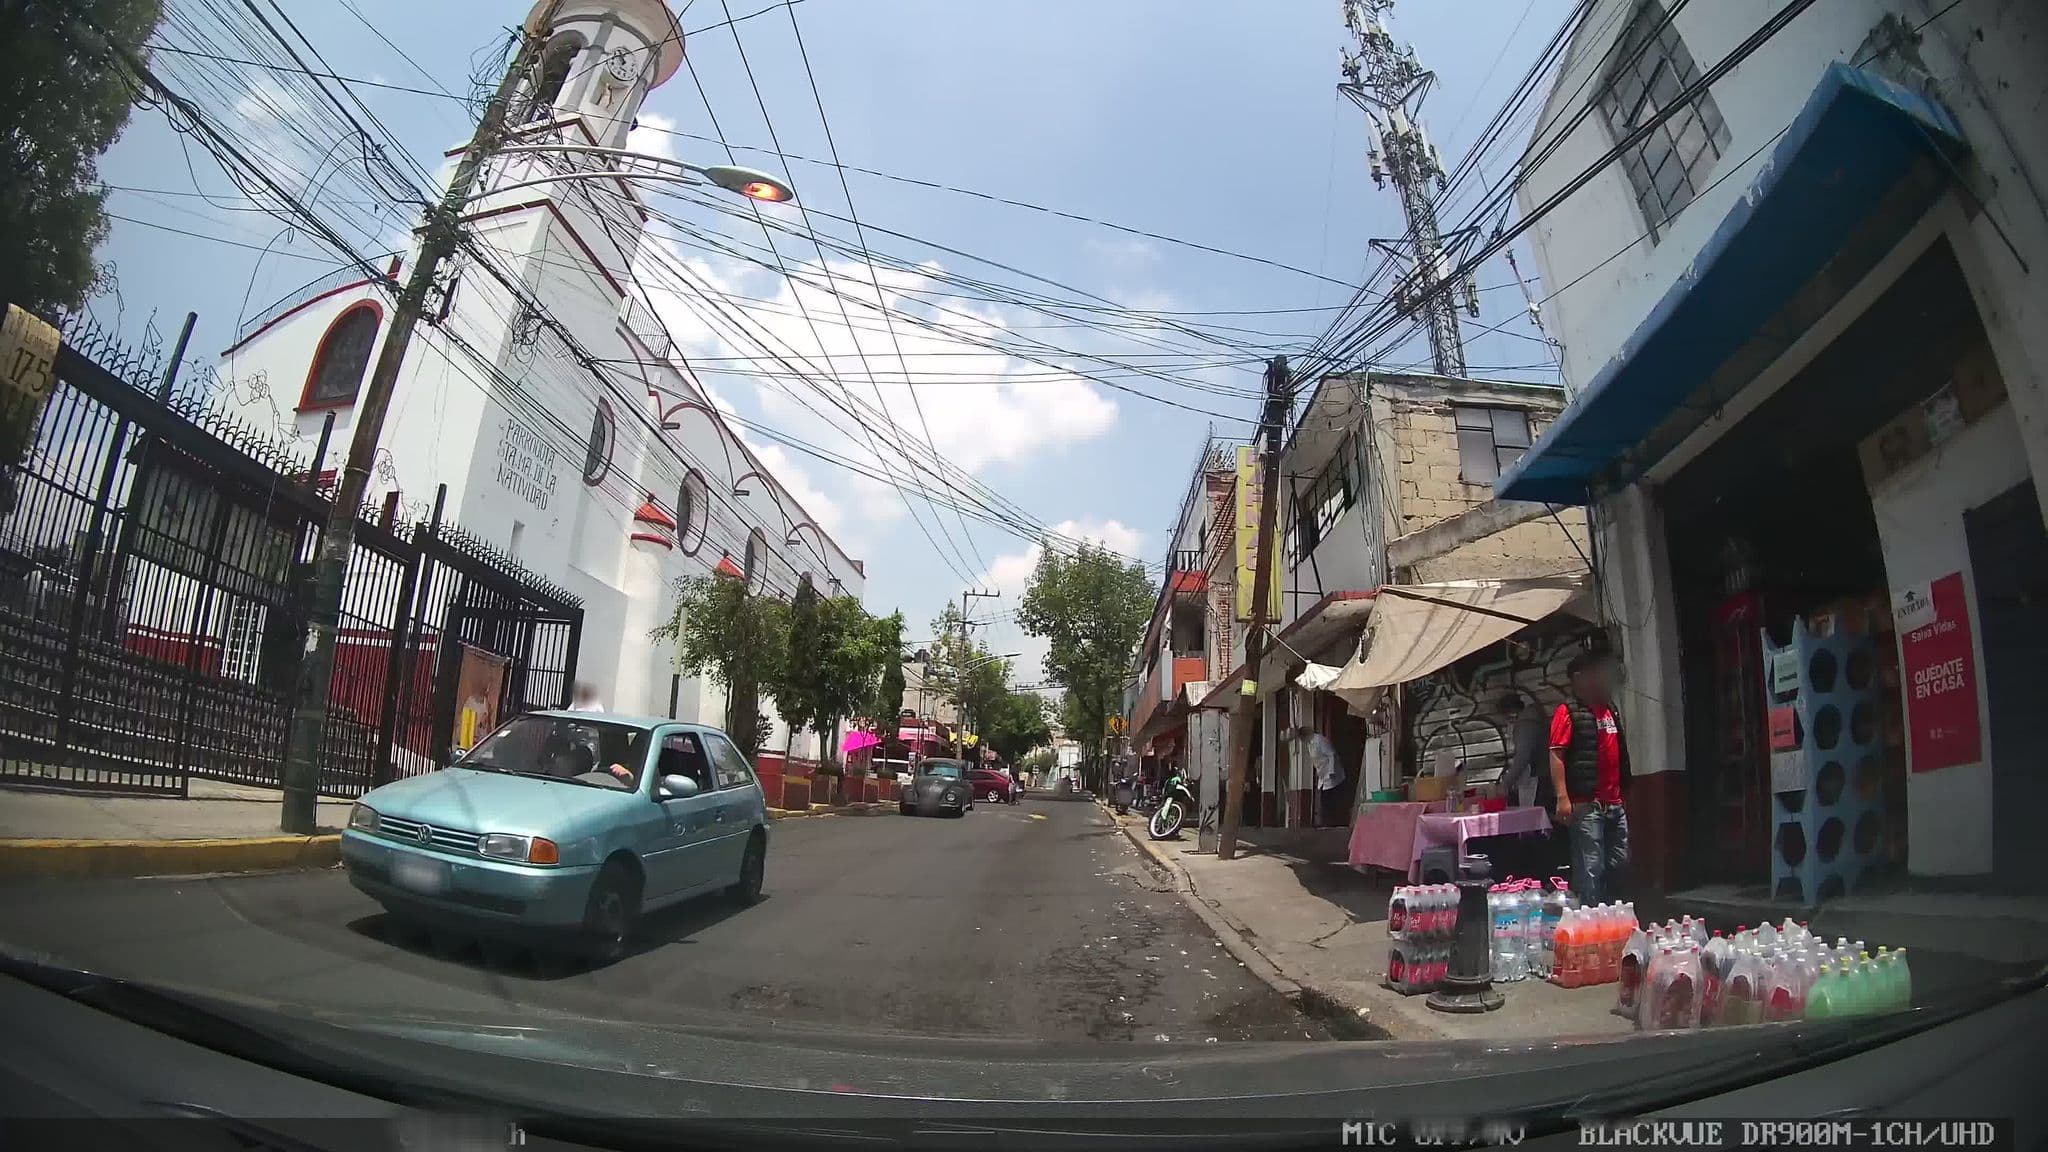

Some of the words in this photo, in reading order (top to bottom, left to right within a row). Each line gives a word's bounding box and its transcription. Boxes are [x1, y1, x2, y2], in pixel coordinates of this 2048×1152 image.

[8, 347, 50, 392] 175
[506, 418, 555, 469] PARROQUIA
[496, 463, 548, 510] NATIVIDAD
[1933, 620, 1957, 637] Vidas
[1915, 656, 1964, 685] QUÉDATE
[1916, 683, 1931, 699] EN
[1933, 673, 1966, 696] CASA
